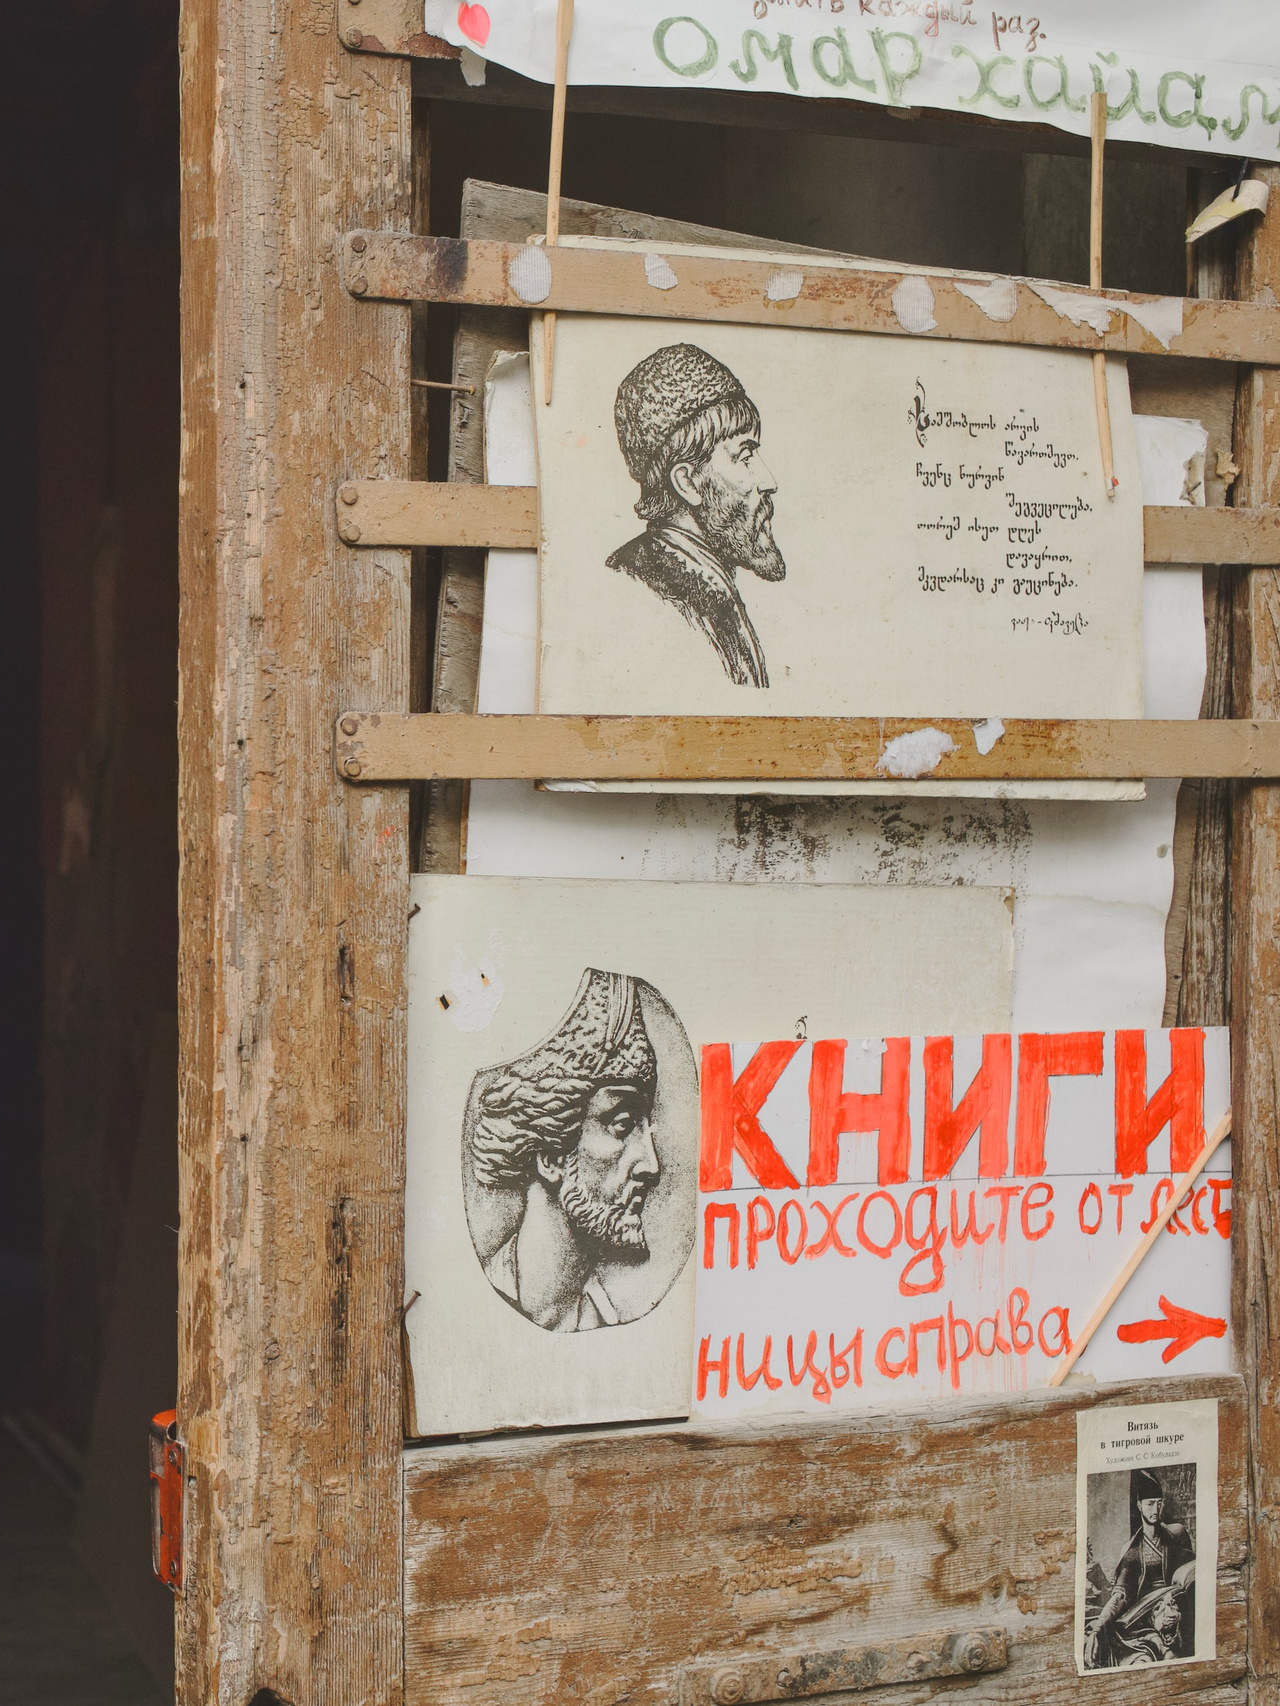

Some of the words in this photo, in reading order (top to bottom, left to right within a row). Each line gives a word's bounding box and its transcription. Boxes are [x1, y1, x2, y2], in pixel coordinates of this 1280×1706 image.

[991, 11, 1047, 52] раз.
[910, 384, 997, 446] სამშობლოს
[1004, 415, 1040, 441] არვის
[1004, 440, 1080, 469] წავართმევთ,
[915, 462, 952, 488] ჩვენც
[958, 464, 1005, 490] ნურვინ
[1005, 492, 1093, 520] შეგვეცილება,
[916, 515, 961, 541] თორემ
[967, 517, 1000, 542] ისეთ
[1007, 520, 1042, 544] დღეს
[1005, 545, 1073, 570] დავაყრით,
[917, 565, 985, 593] მკვდარსაც
[991, 576, 1005, 594] კი
[1012, 571, 1079, 597] გაეცინება.
[699, 1027, 1207, 1192] КНИГИ
[703, 1182, 1055, 1297] проходите
[696, 1326, 865, 1404] ницы
[874, 1286, 1073, 1390] справа
[1100, 1441, 1106, 1449] в
[1111, 1435, 1151, 1449] тигровой
[1156, 1433, 1185, 1445] шкуре
[1127, 1421, 1159, 1432] Витязь
